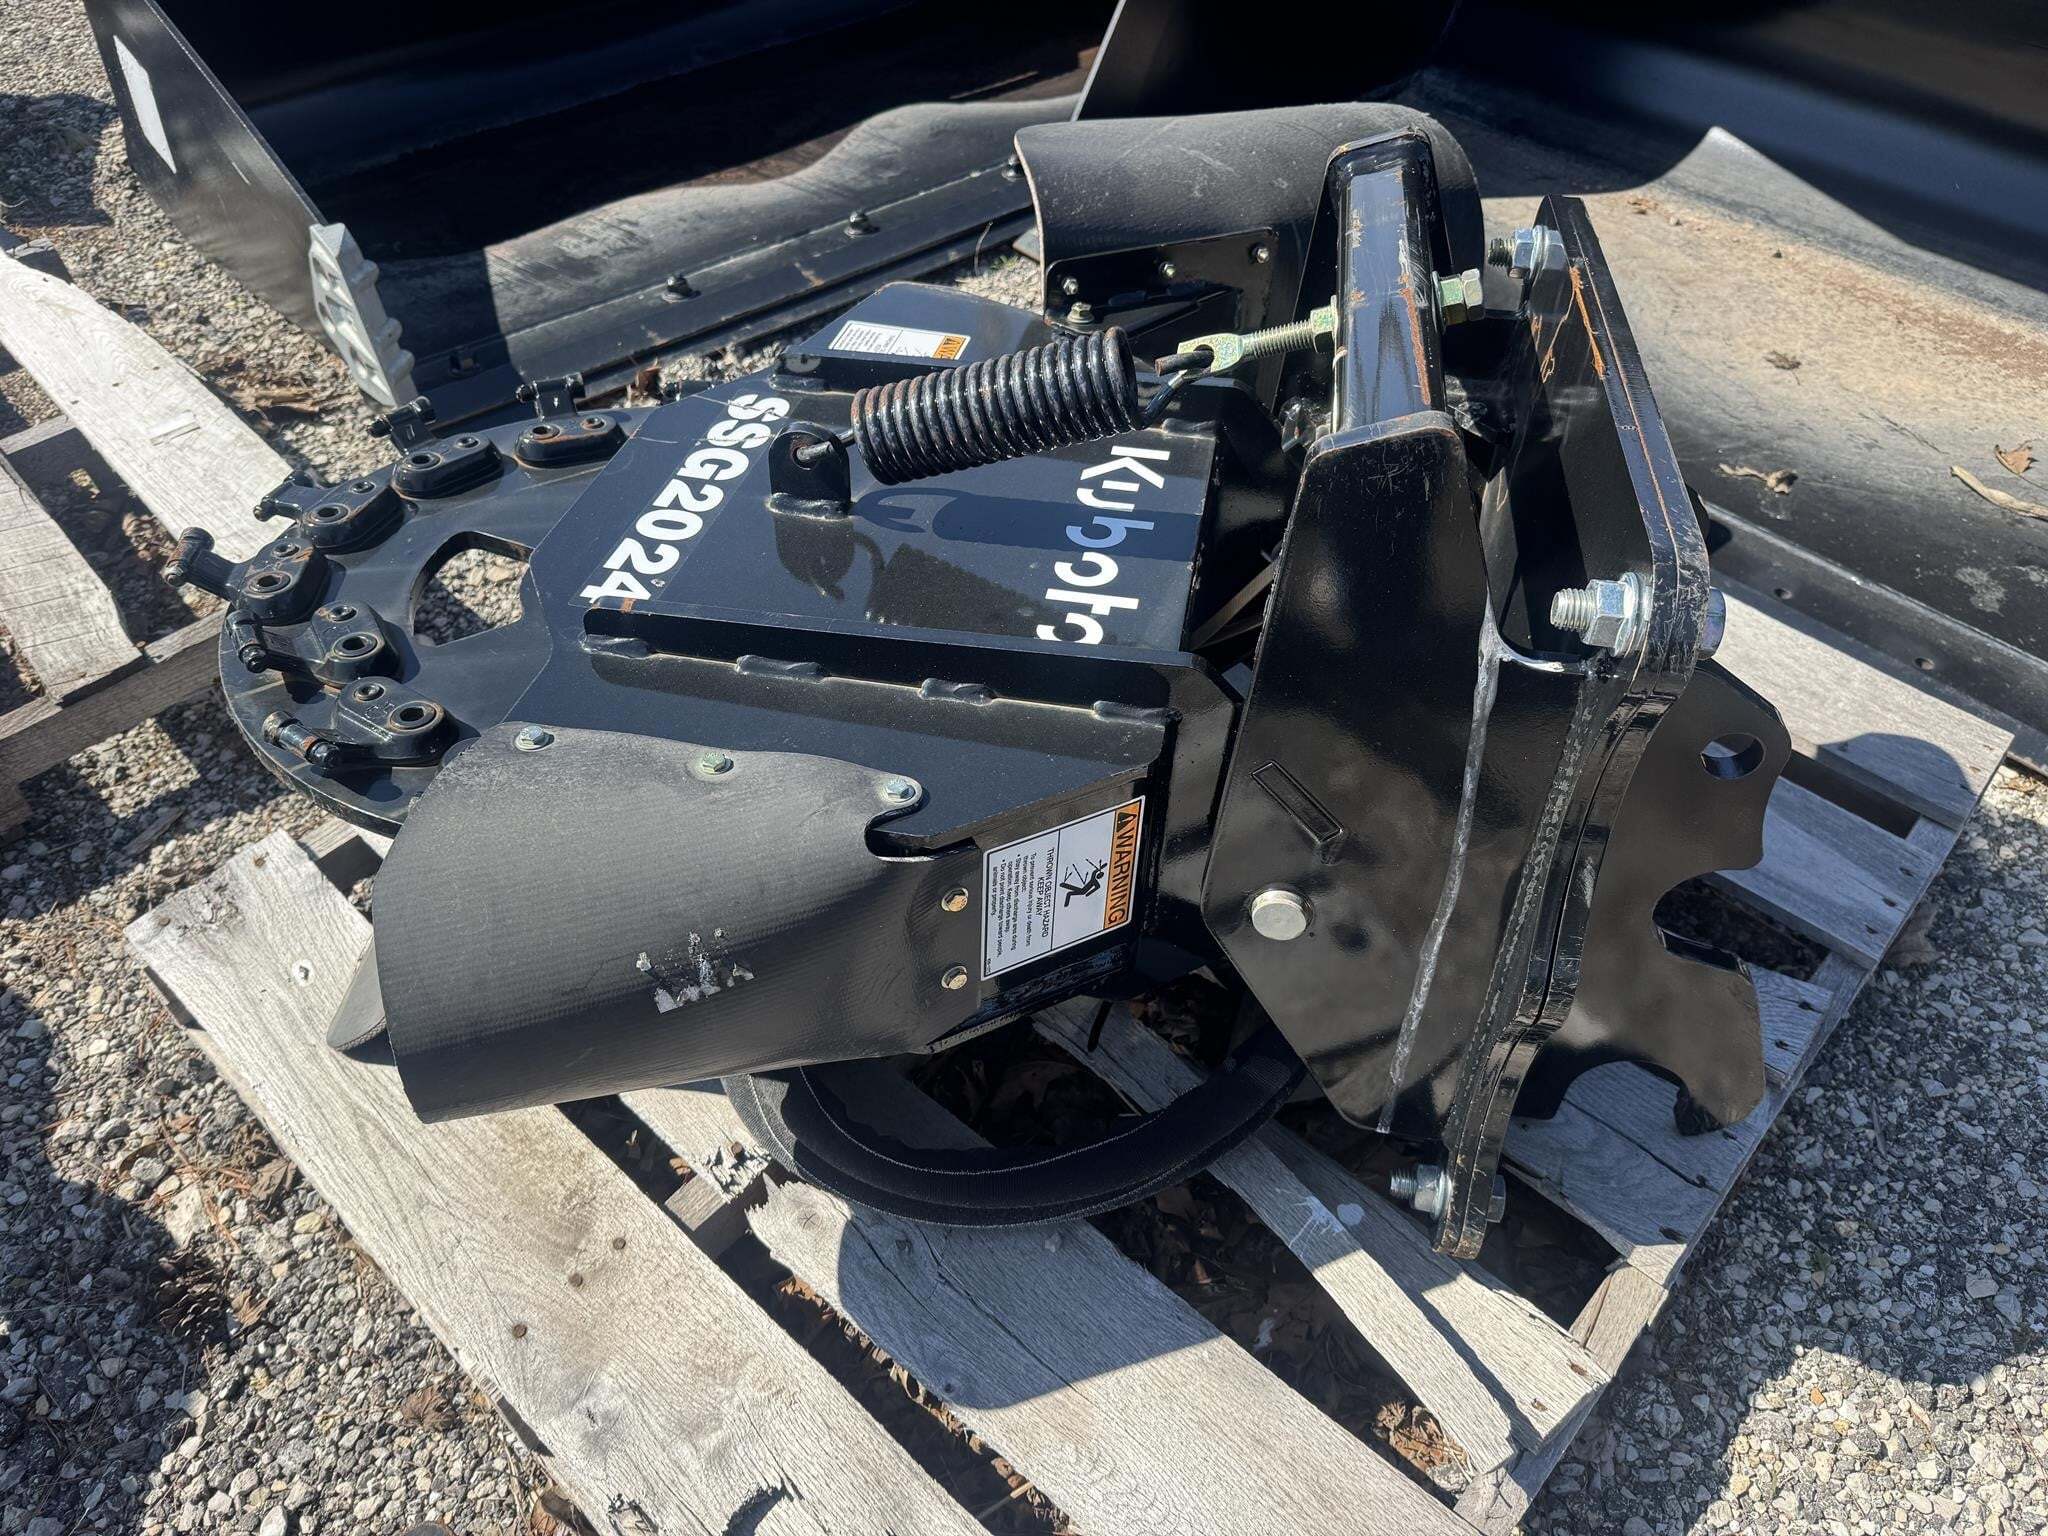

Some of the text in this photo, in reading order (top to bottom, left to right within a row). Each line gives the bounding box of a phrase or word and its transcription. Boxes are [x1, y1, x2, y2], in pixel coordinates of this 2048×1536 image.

[580, 394, 790, 604] SSG2024
[1036, 876, 1045, 917] KEEP AWAY
[1042, 848, 1054, 938] THROWN OBJECT HAZARD
[1108, 828, 1136, 924] WARNING
